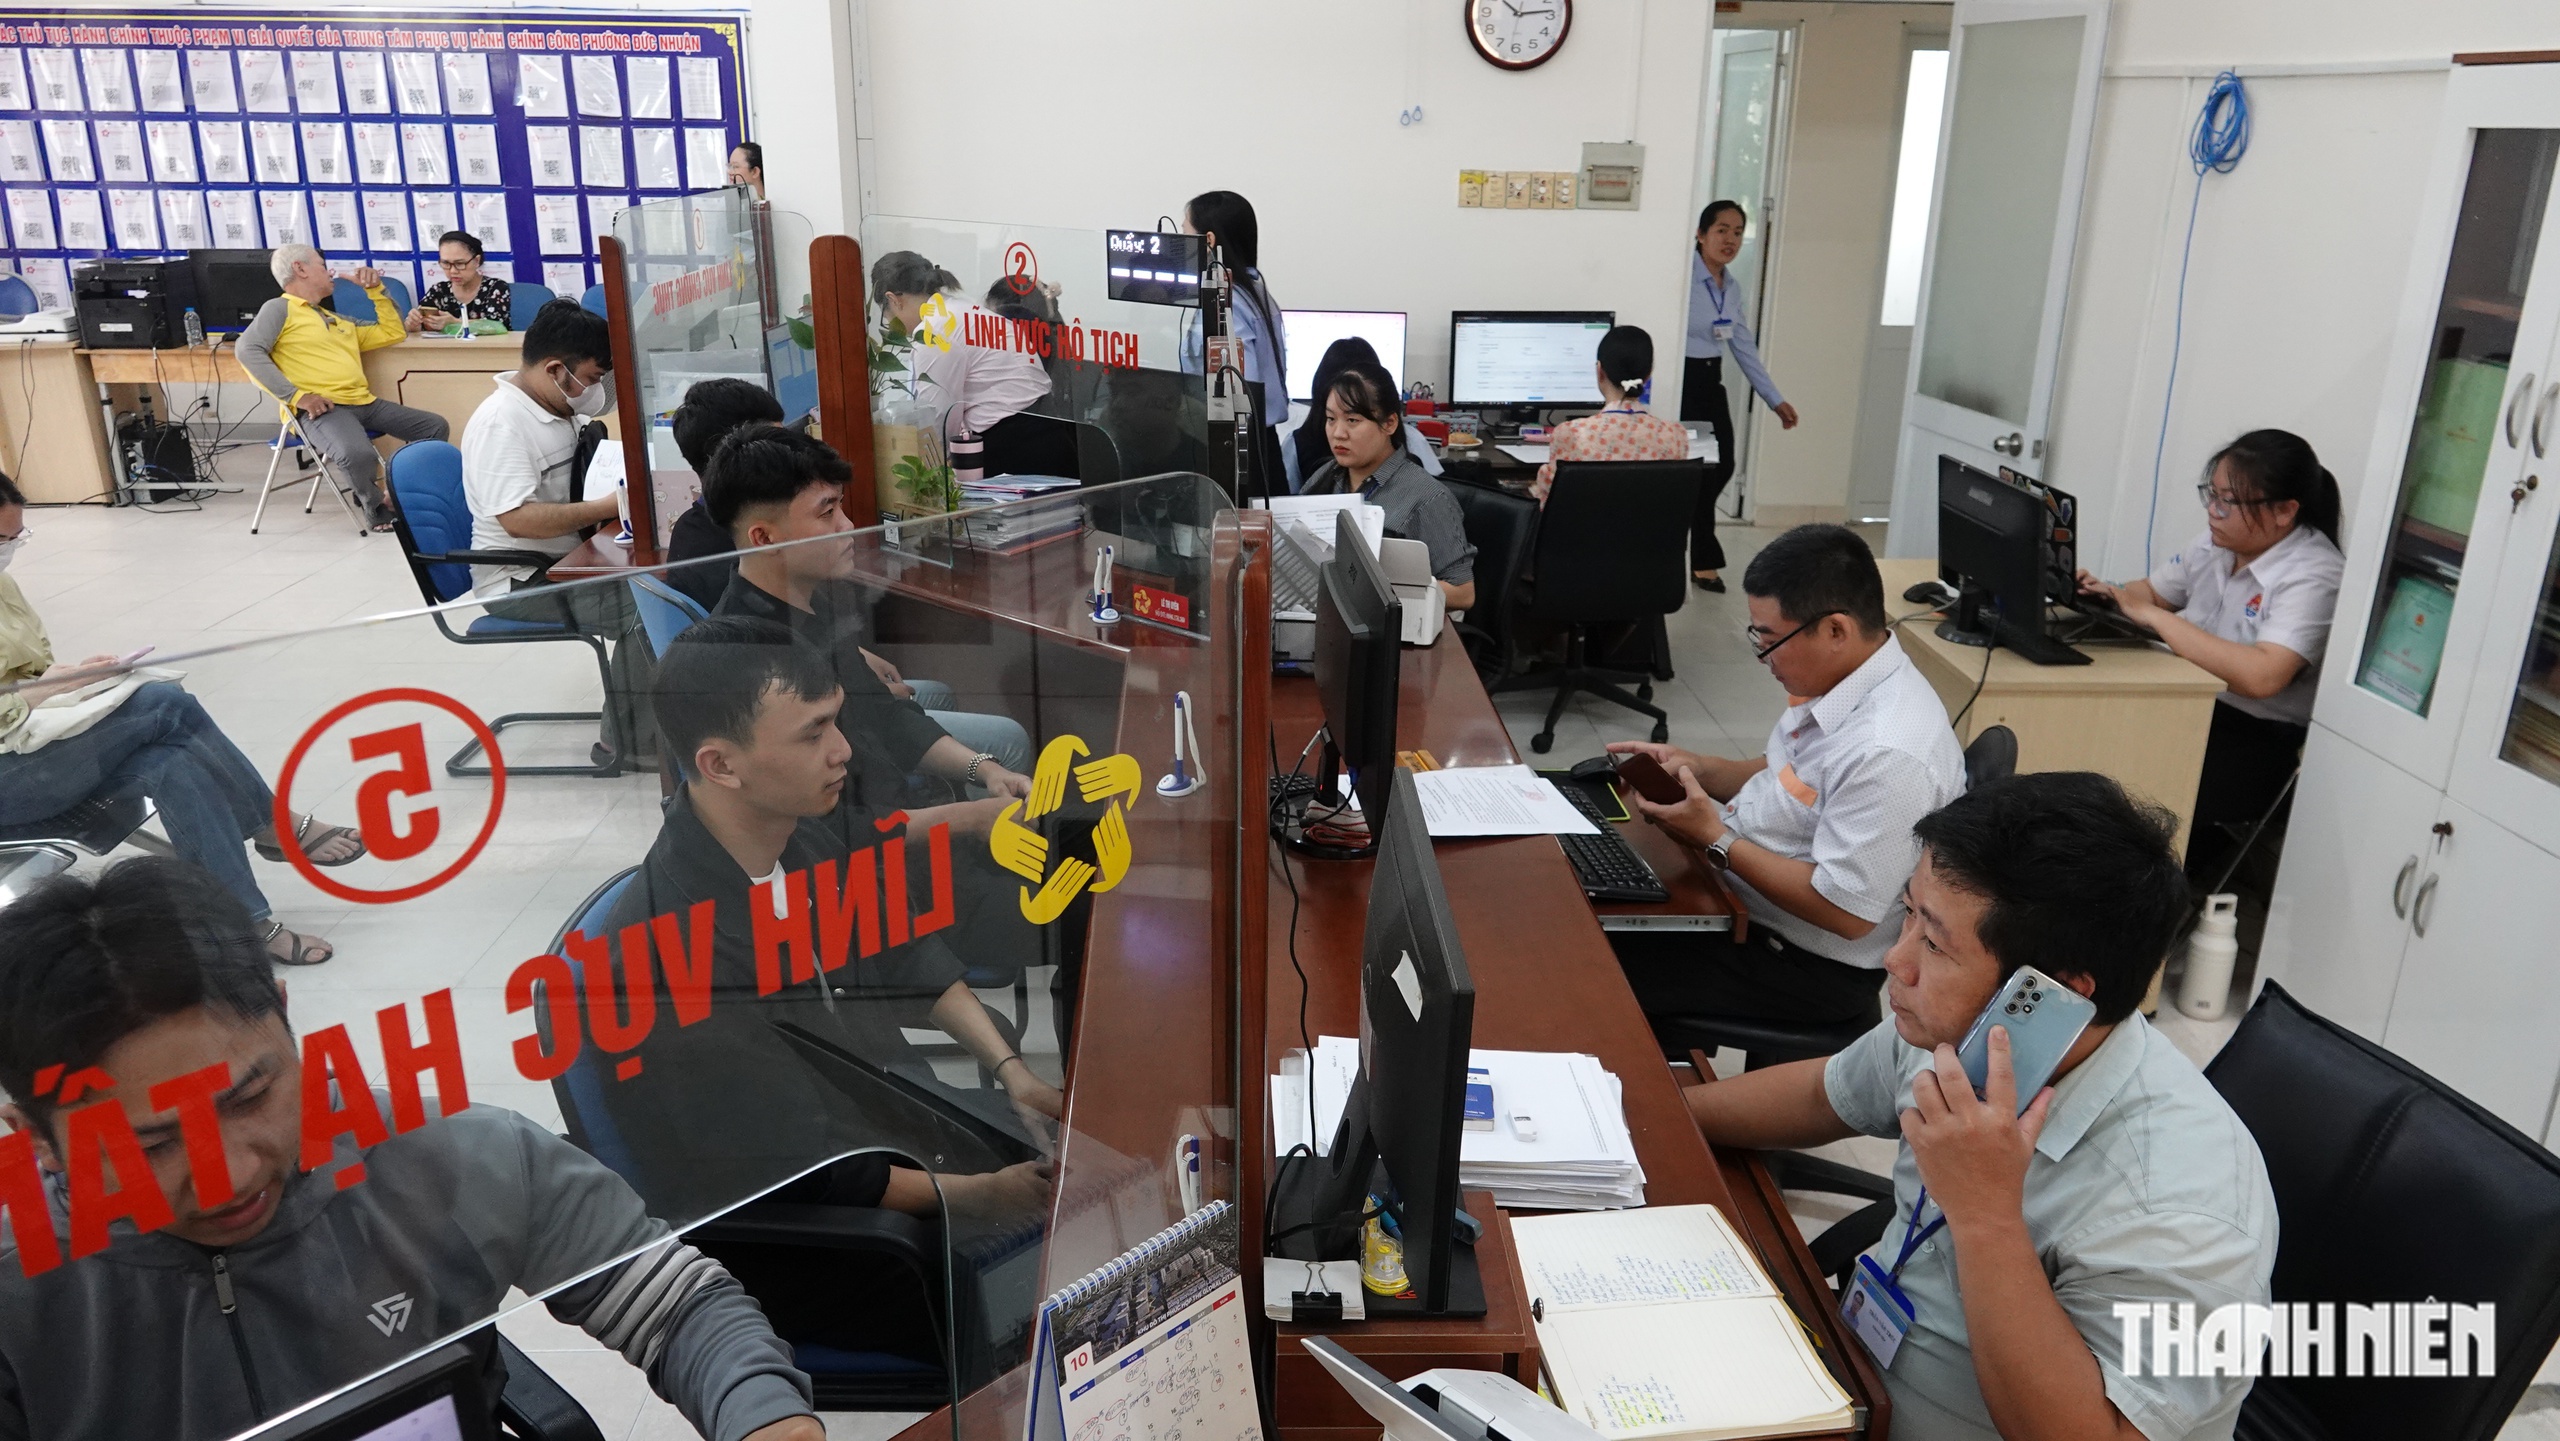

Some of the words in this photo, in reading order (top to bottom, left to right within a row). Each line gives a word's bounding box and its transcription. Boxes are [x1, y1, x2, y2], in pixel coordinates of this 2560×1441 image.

[1481, 7, 1492, 17] 9
[1484, 24, 1495, 34] 8
[1539, 27, 1549, 37] 4
[17, 21, 44, 44] THỦ
[44, 26, 70, 47] TỤC
[71, 24, 108, 44] HÀNH
[109, 24, 149, 45] CHÍNH
[150, 25, 191, 48] THUỘC
[192, 28, 231, 49] PHẠM
[231, 29, 246, 46] VI
[248, 24, 274, 46] GIẢI
[276, 25, 314, 48] QUYẾT
[315, 24, 342, 47] CỦA
[343, 30, 384, 48] TRUNG
[386, 28, 414, 49] TÂM
[415, 31, 449, 52] PHỤC
[450, 31, 468, 52] VỤ
[470, 29, 505, 49] HÀNH
[507, 29, 545, 49] CHÍNH
[547, 30, 580, 50] CÔNG
[581, 30, 631, 51] PHƯỜNG
[632, 31, 658, 51] ĐỨC
[658, 32, 701, 55] NHUẬN
[1495, 38, 1505, 47] 7
[1511, 43, 1521, 53] 6
[1528, 39, 1538, 49] 5
[1150, 236, 1160, 254] 2
[1015, 251, 1027, 285] 2
[964, 305, 1007, 351] LĨNH
[1012, 317, 1052, 364] VỰC
[1056, 317, 1085, 371] HỘ
[1090, 328, 1139, 375] TỊCH
[1070, 1351, 1088, 1371] 10
